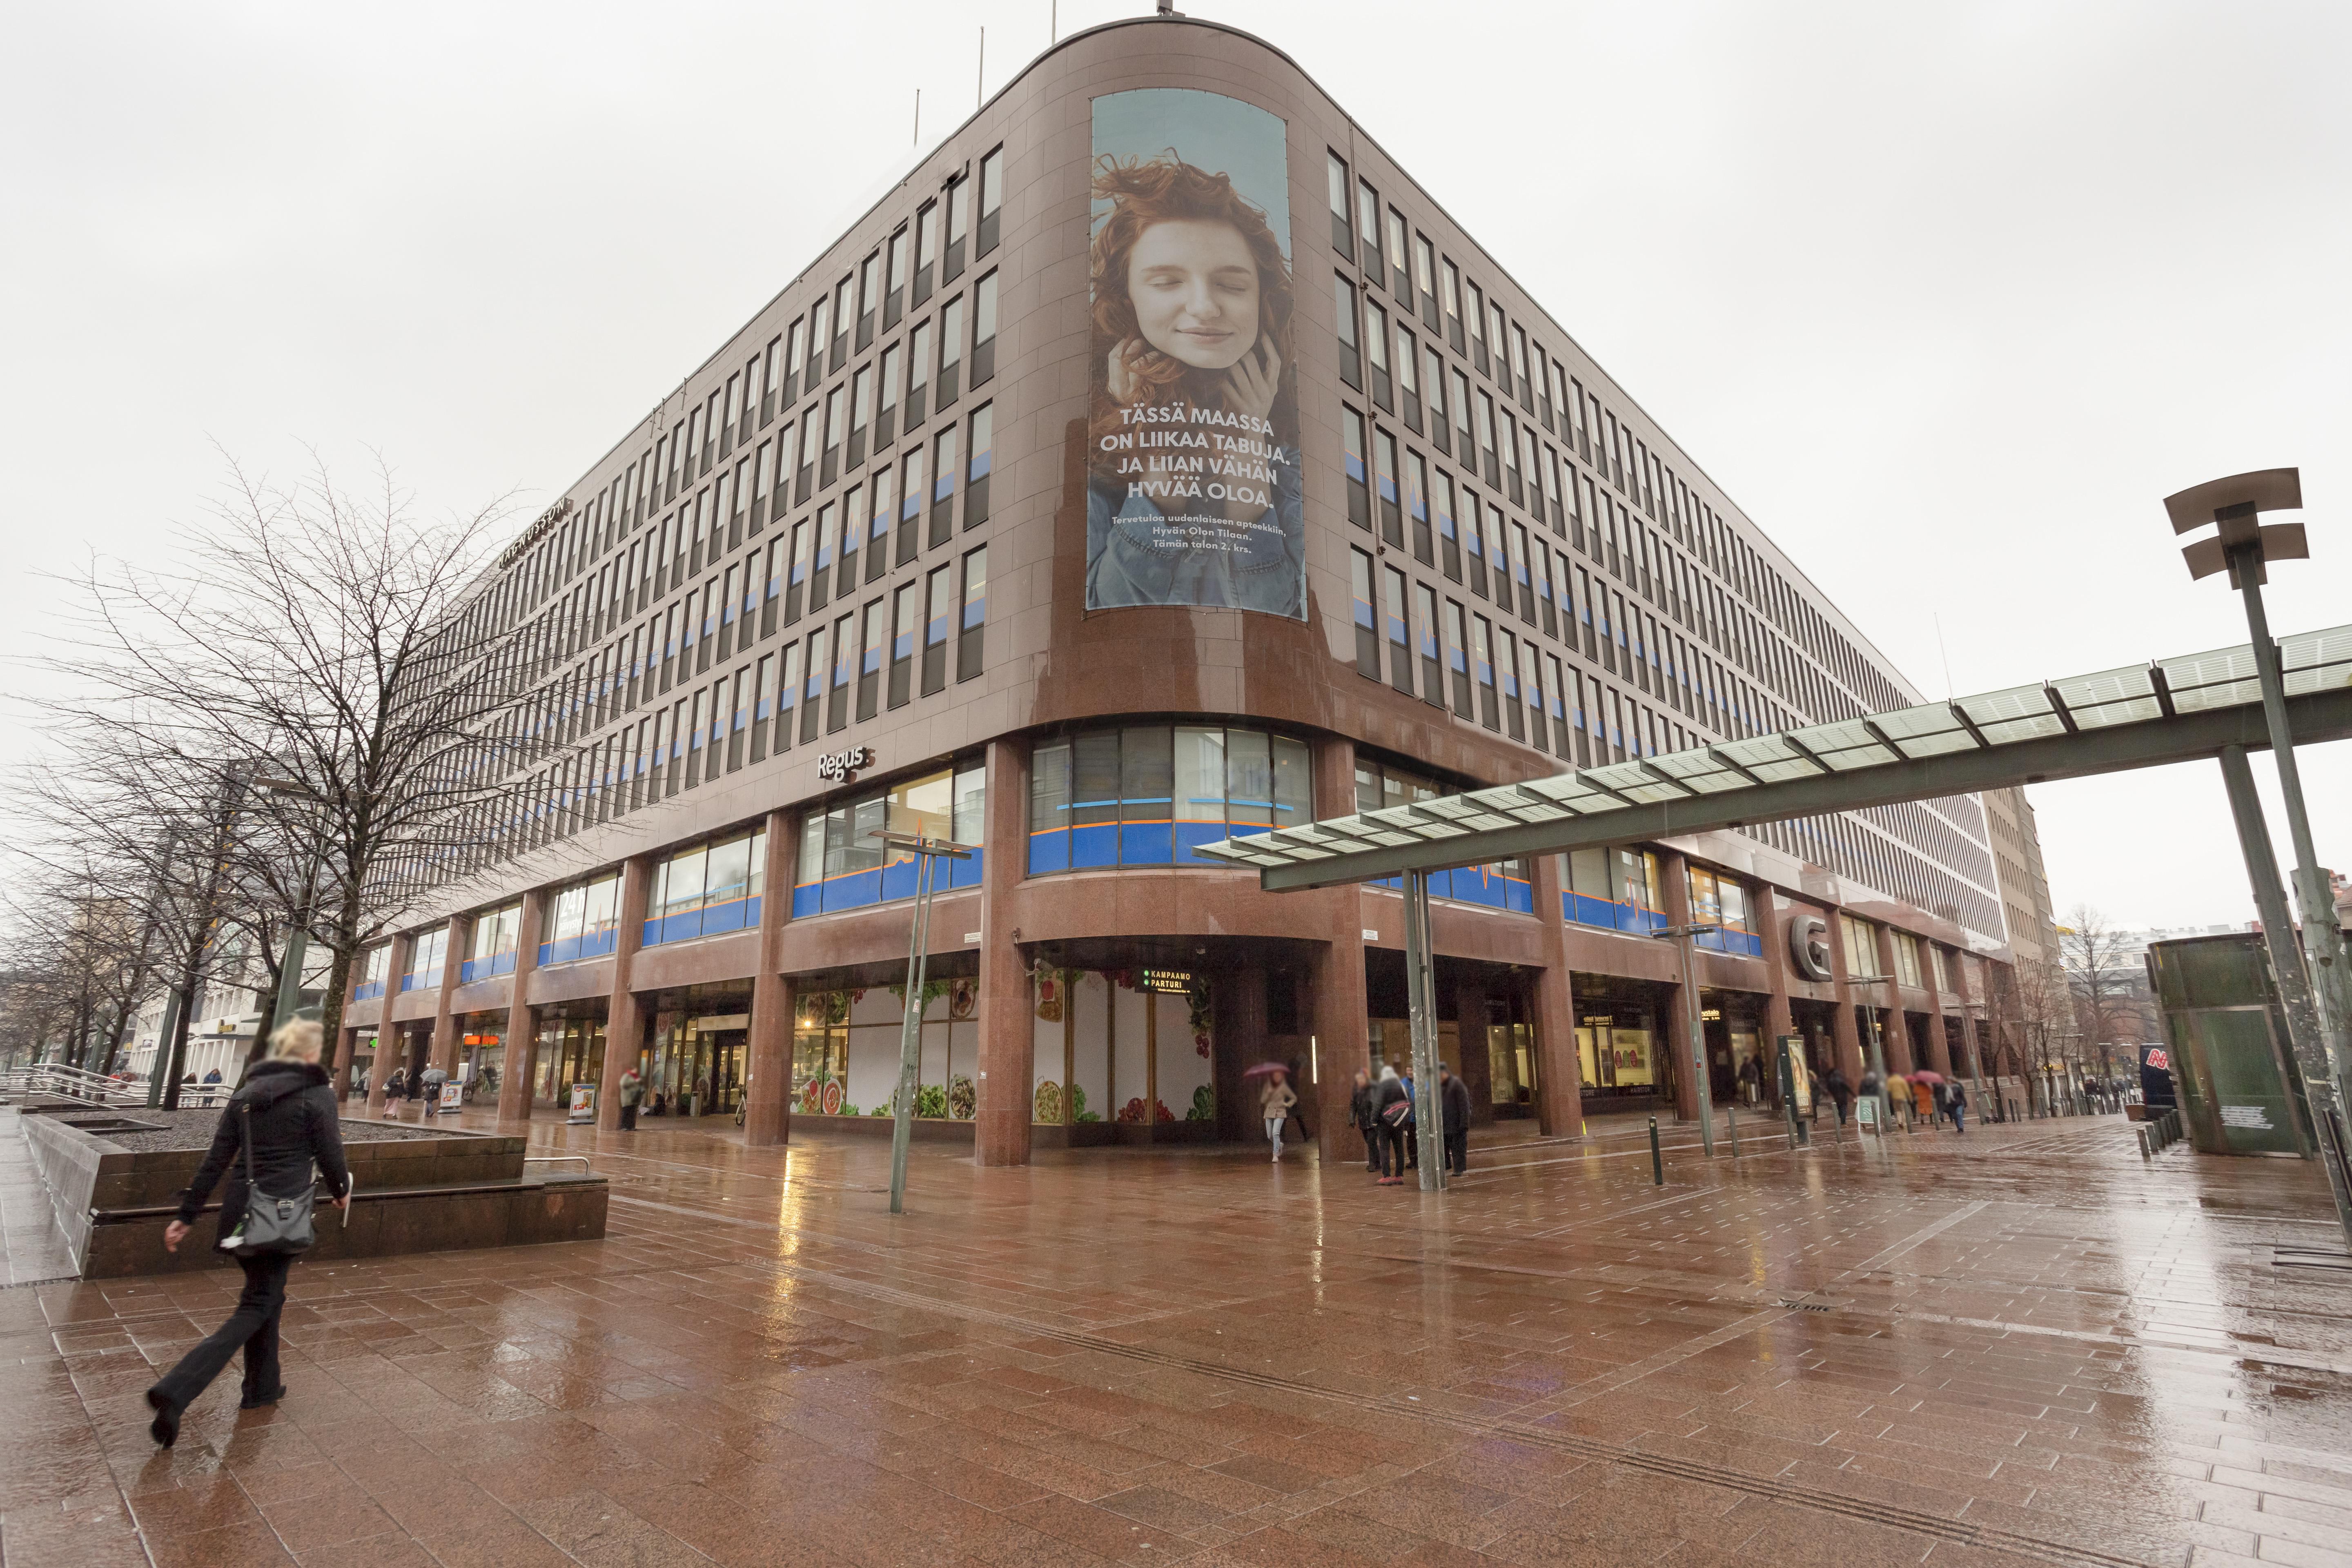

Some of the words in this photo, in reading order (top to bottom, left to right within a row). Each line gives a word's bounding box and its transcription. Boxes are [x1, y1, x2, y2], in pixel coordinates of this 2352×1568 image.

[1120, 401, 1187, 425] TÄSSÄ
[1190, 408, 1275, 437] MAASSA
[1100, 433, 1133, 451] ON
[1139, 431, 1209, 448] LIIKAA
[1213, 434, 1290, 466] TABUJA.
[1117, 457, 1144, 474] JA
[1149, 456, 1203, 472] LIIAN
[1208, 454, 1277, 485] VÄHÄN
[1128, 475, 1203, 498] HYVÄÄ
[1207, 483, 1274, 509] OLOA.
[498, 497, 566, 568] MAGNUSSON
[1112, 514, 1165, 525] Tervetuloa
[1168, 514, 1234, 526] uudenlaiseen
[1236, 520, 1287, 537] apteekkiin,
[1152, 527, 1186, 536] Hyvän
[1189, 527, 1215, 536] Olon
[1217, 529, 1252, 541] Tilaan.
[1153, 539, 1189, 548] Tämän
[1191, 541, 1218, 549] talon
[1221, 543, 1231, 551] 2.
[1233, 544, 1252, 554] krs.
[817, 746, 863, 782] Regus
[1151, 970, 1190, 980] KAMPAAMO
[1151, 980, 1182, 989] PARTURI
